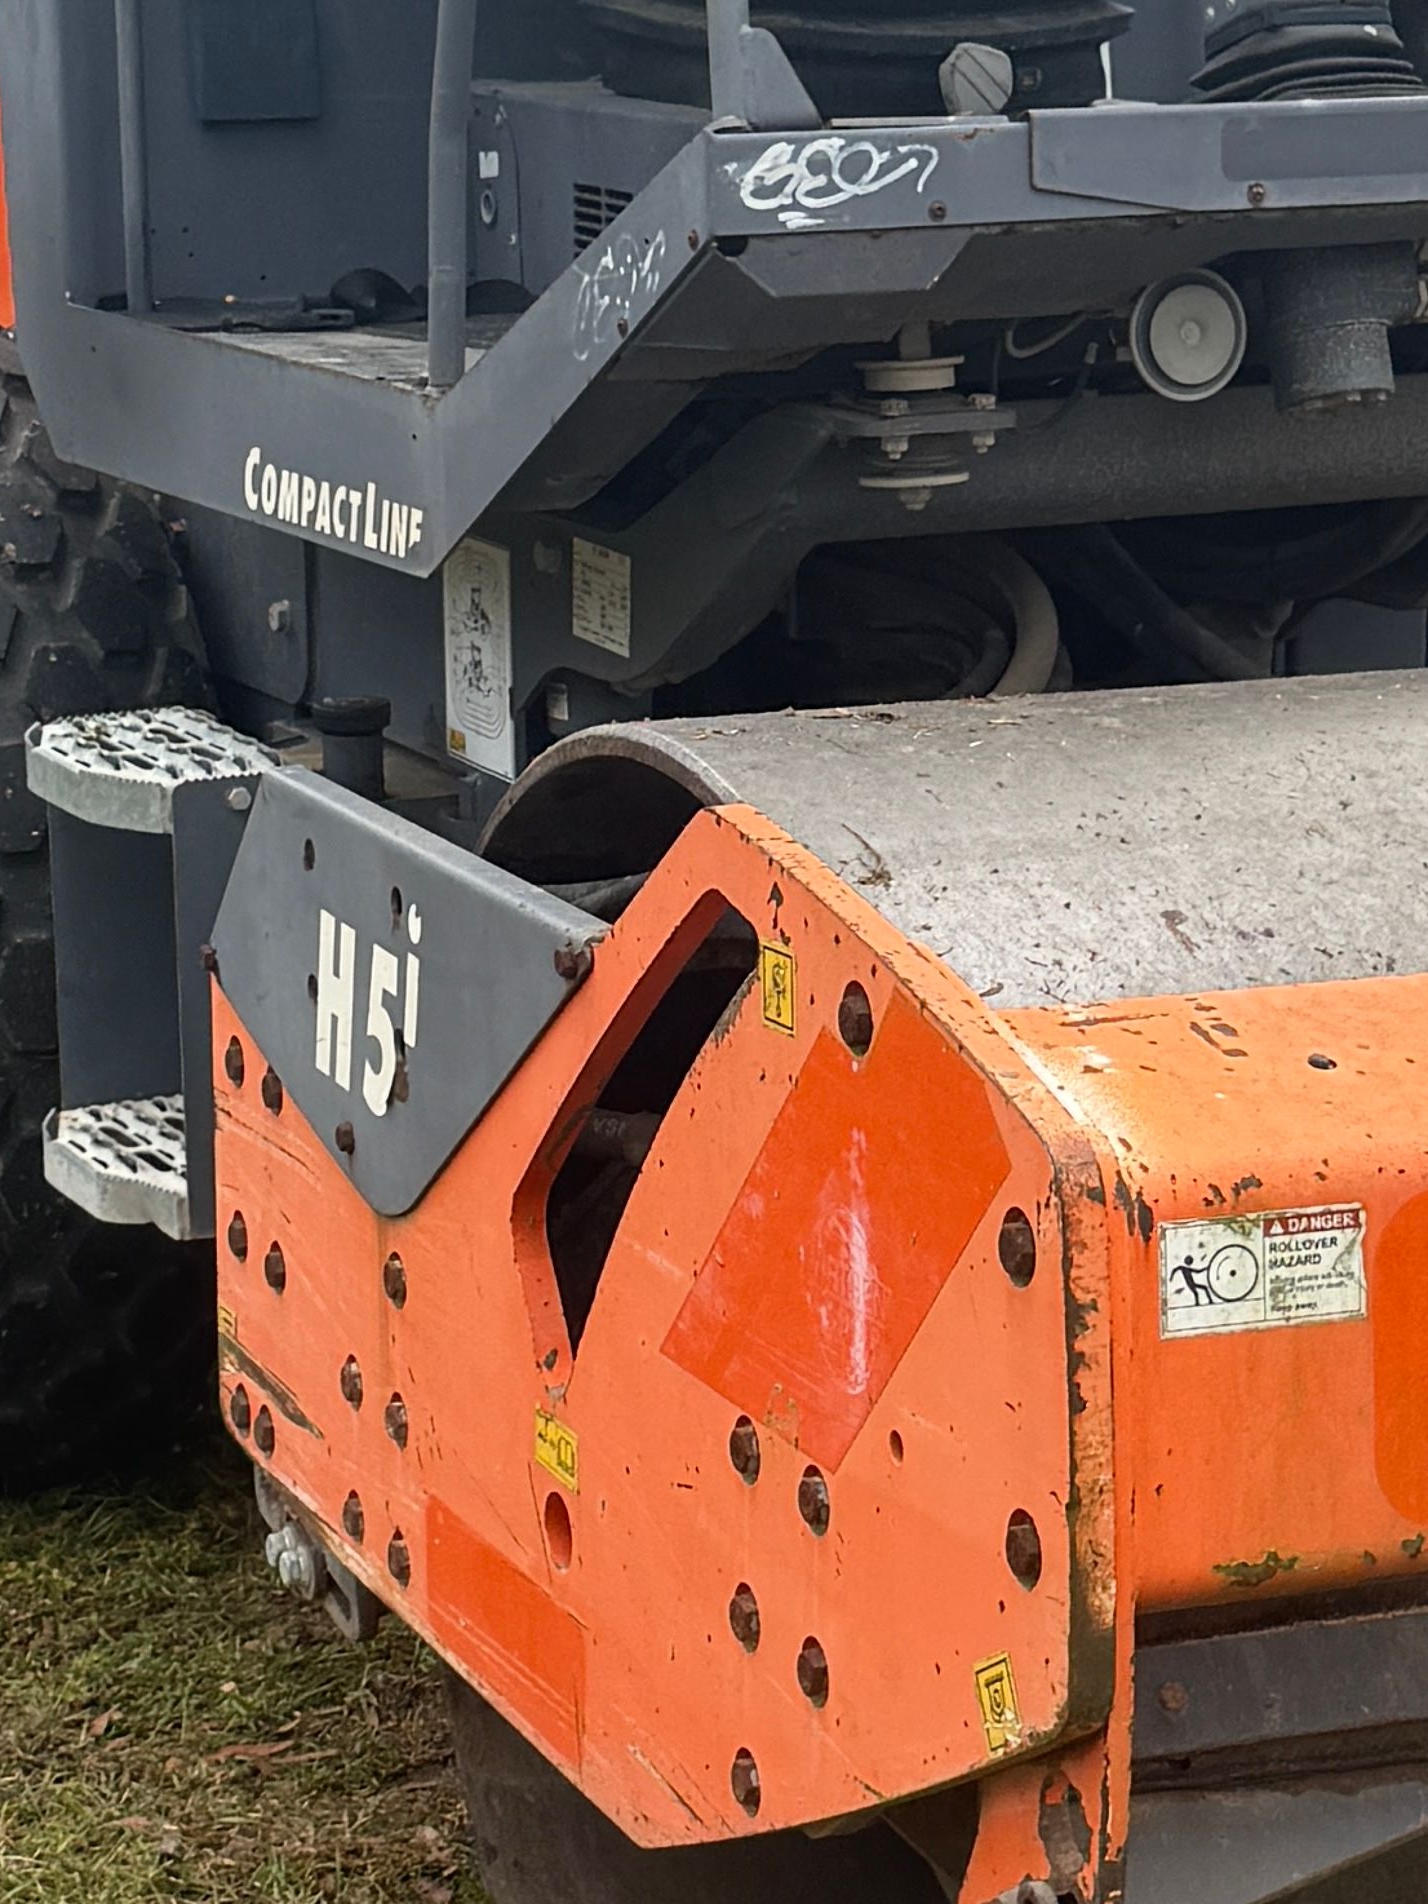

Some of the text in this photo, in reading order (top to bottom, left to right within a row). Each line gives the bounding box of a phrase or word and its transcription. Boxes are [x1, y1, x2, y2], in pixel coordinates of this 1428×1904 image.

[1287, 1212, 1355, 1232] DANGER
[1269, 1236, 1338, 1254] ROLLOVER
[1269, 1253, 1322, 1270] HAZARD
